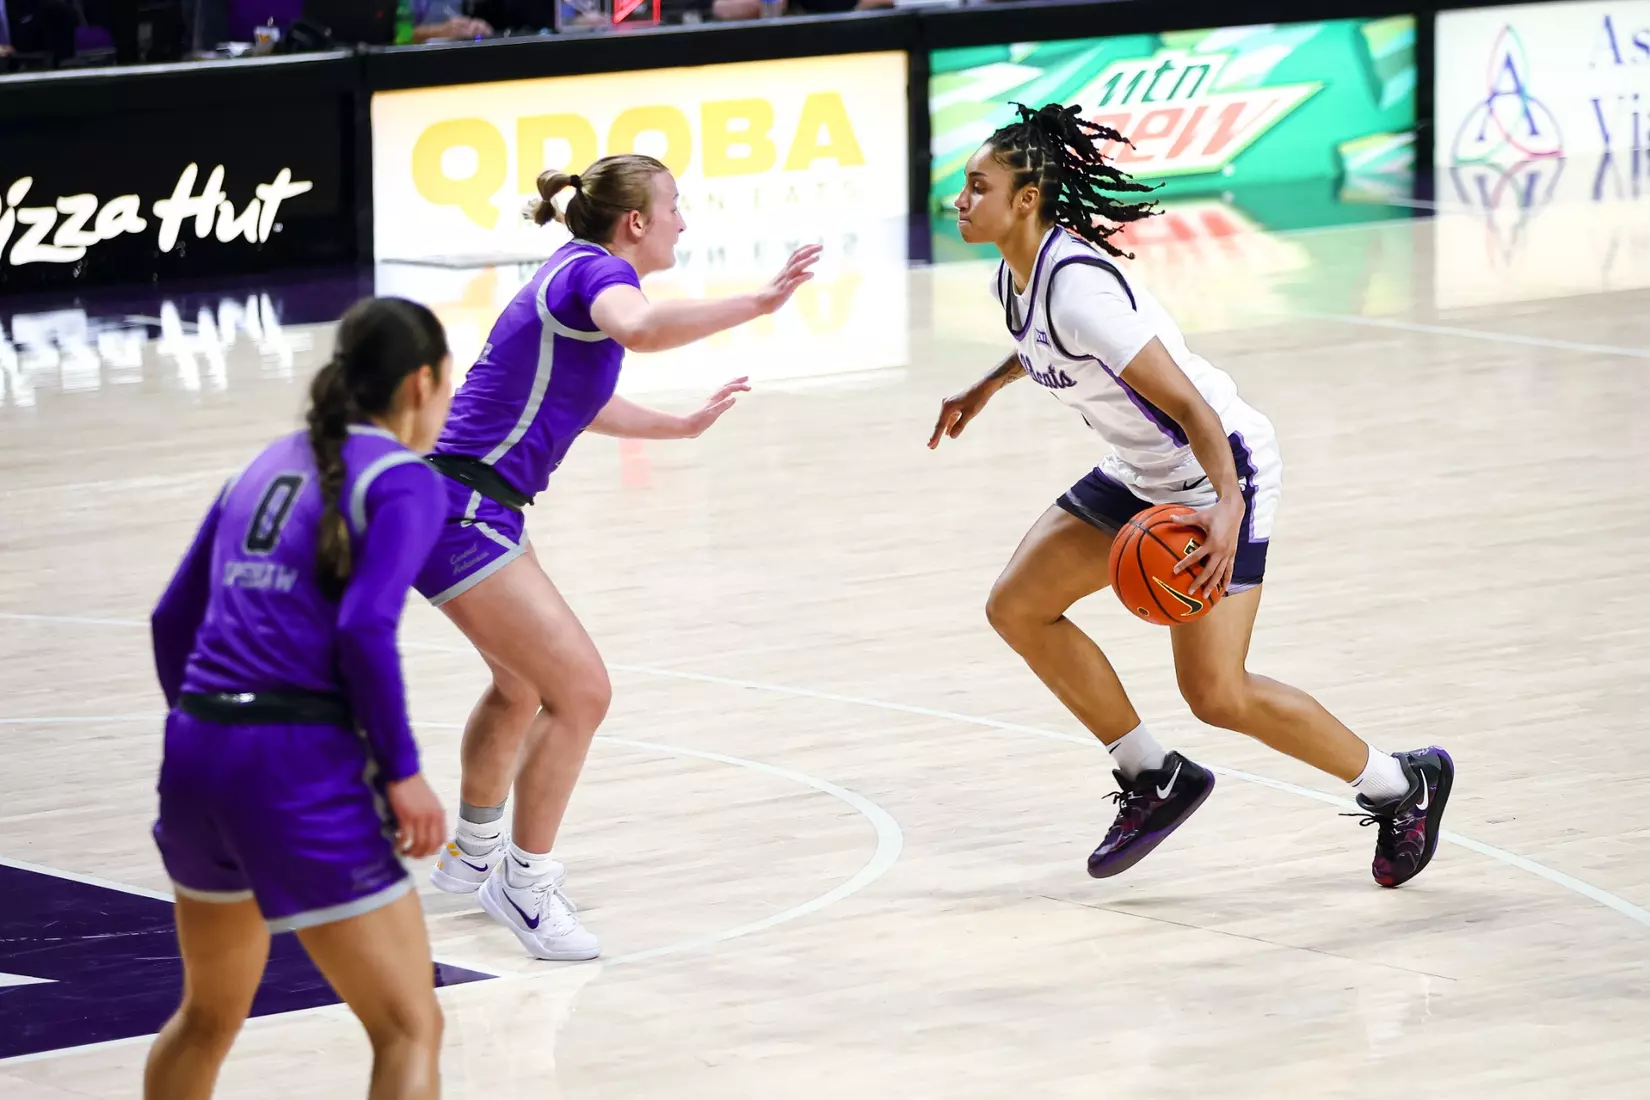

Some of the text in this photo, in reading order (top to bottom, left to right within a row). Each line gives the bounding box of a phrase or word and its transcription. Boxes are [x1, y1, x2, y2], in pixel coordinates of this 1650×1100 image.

[411, 92, 866, 231] QDOBA
[0, 162, 313, 266] izza Hut
[243, 472, 308, 556] 0
